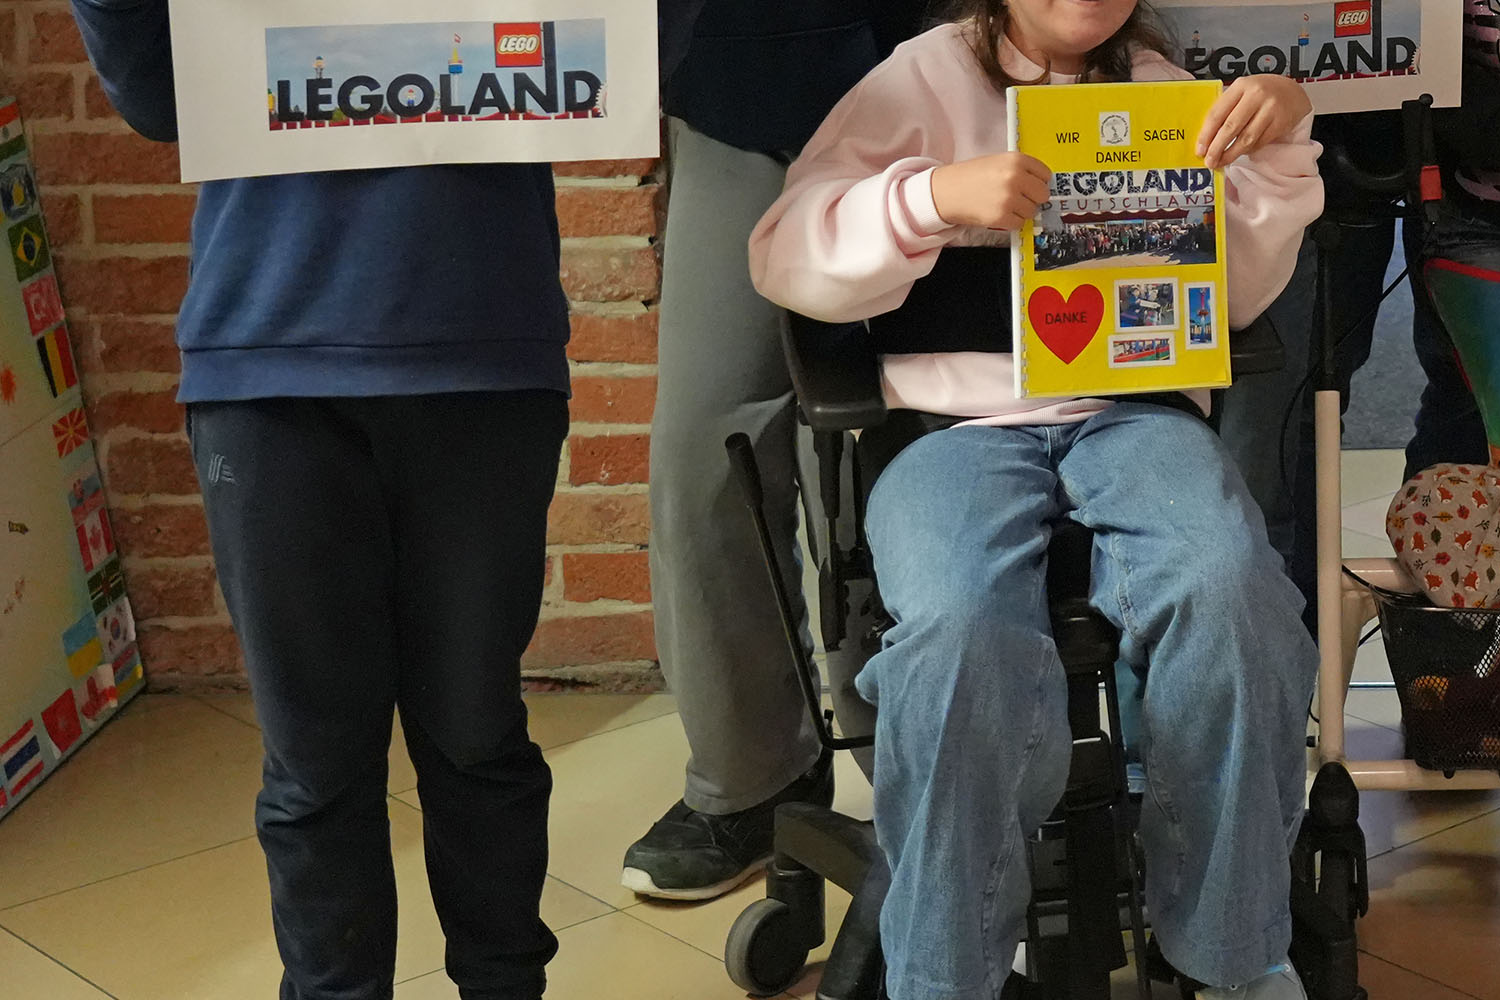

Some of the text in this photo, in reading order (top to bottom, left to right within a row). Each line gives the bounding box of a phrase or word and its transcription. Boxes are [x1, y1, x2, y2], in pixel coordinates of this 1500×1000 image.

[1338, 10, 1369, 26] LEGO
[498, 34, 539, 53] LEGO
[277, 22, 603, 122] LEGOLAND
[1056, 129, 1185, 144] WIR SAGEN
[1096, 151, 1141, 164] DANKE!
[1041, 194, 1215, 211] DEUTSCHLAND
[1045, 311, 1087, 325] DANKE
